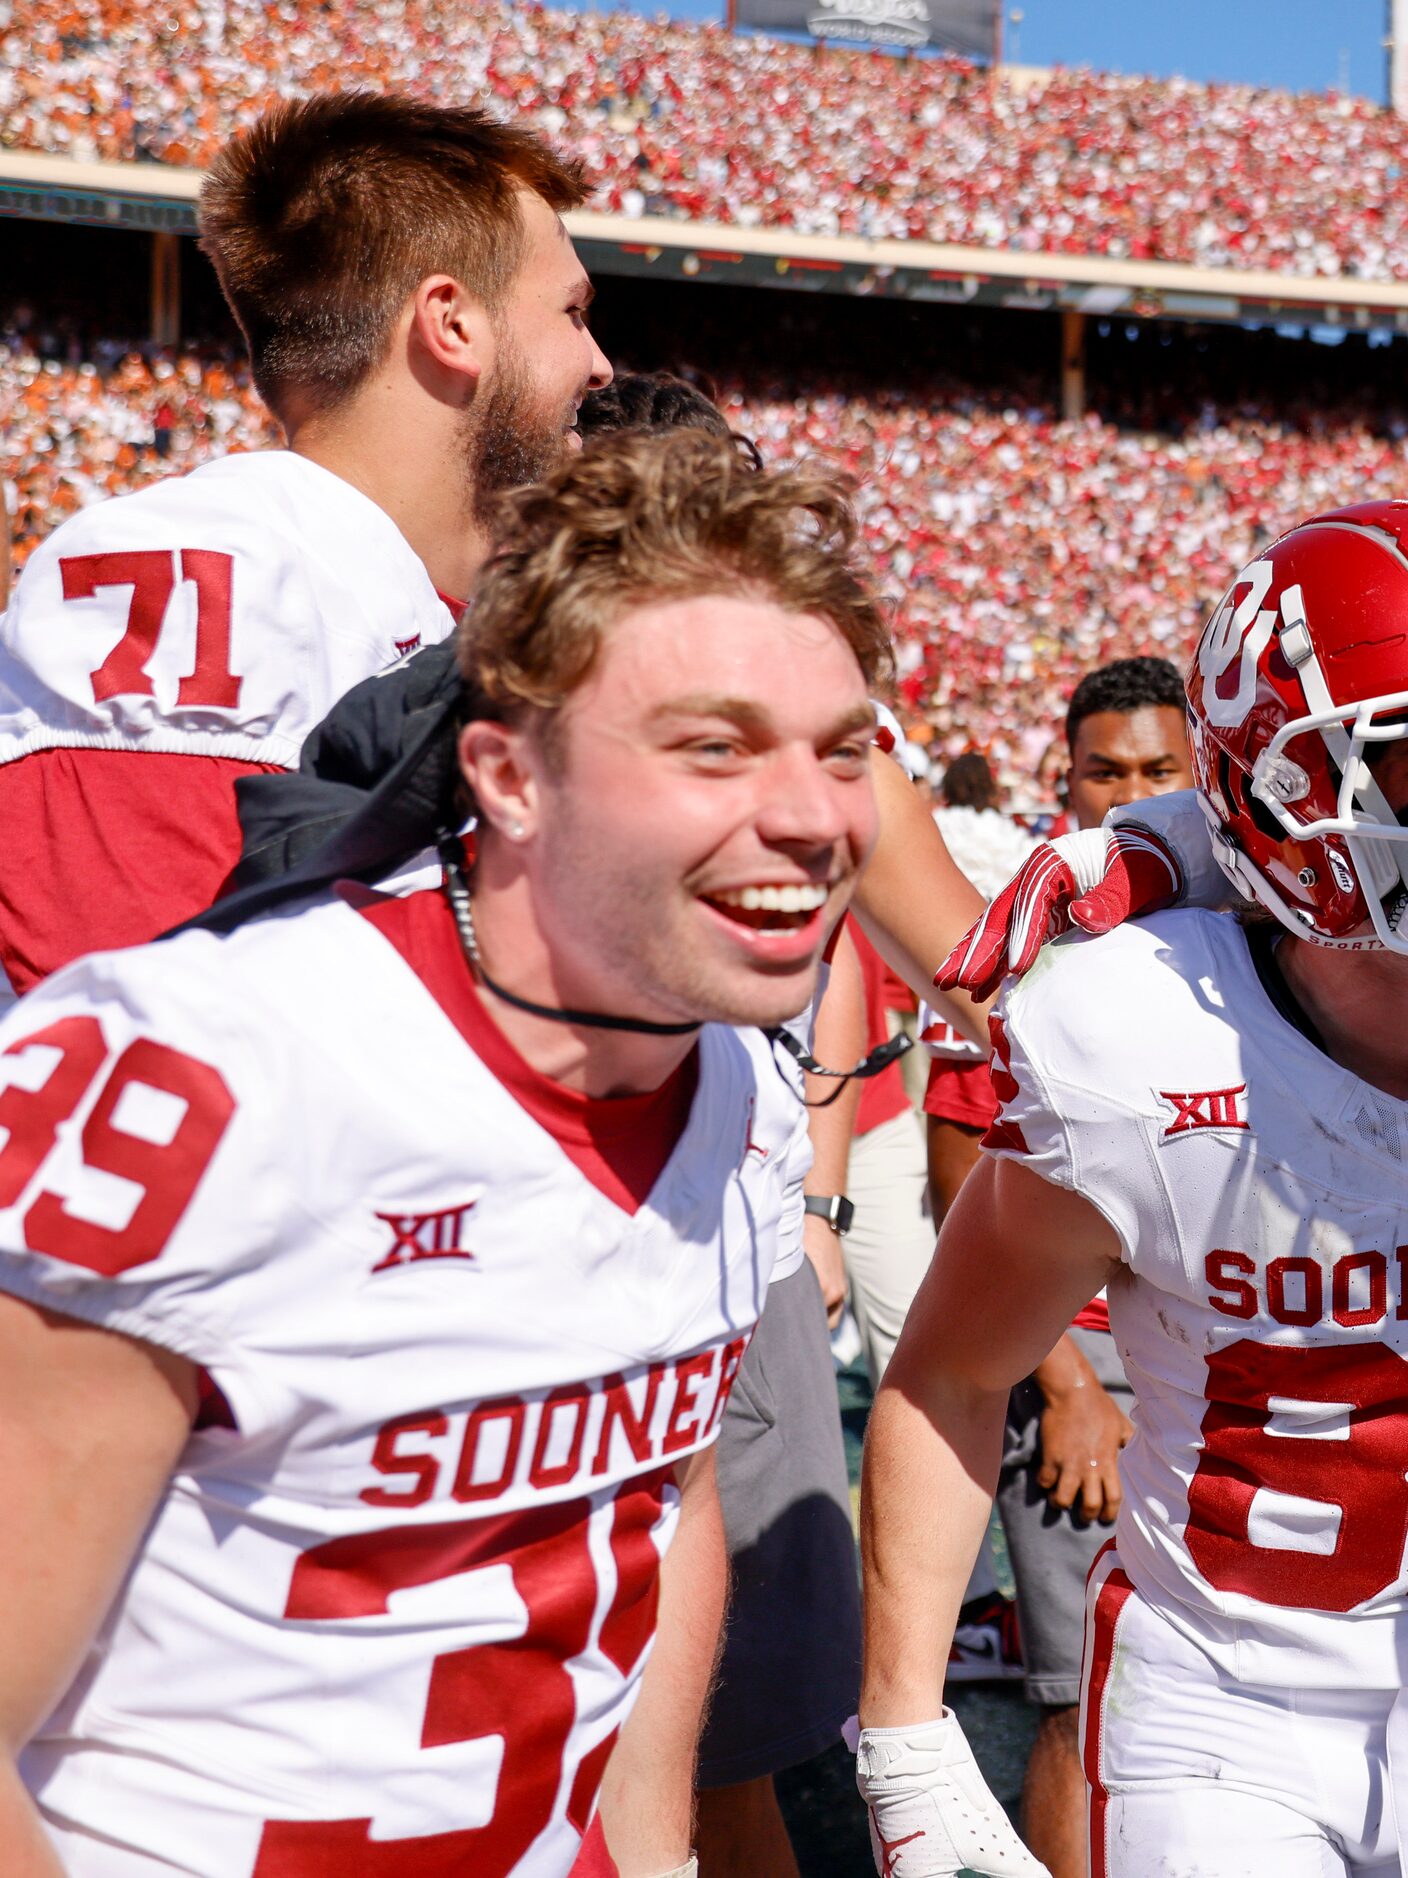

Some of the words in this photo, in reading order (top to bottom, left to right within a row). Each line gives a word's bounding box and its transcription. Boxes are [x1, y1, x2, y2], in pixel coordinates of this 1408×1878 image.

[58, 548, 244, 709] 71
[1159, 1083, 1251, 1136] XII
[371, 1201, 477, 1274] XII
[359, 1320, 758, 1509] SOONER
